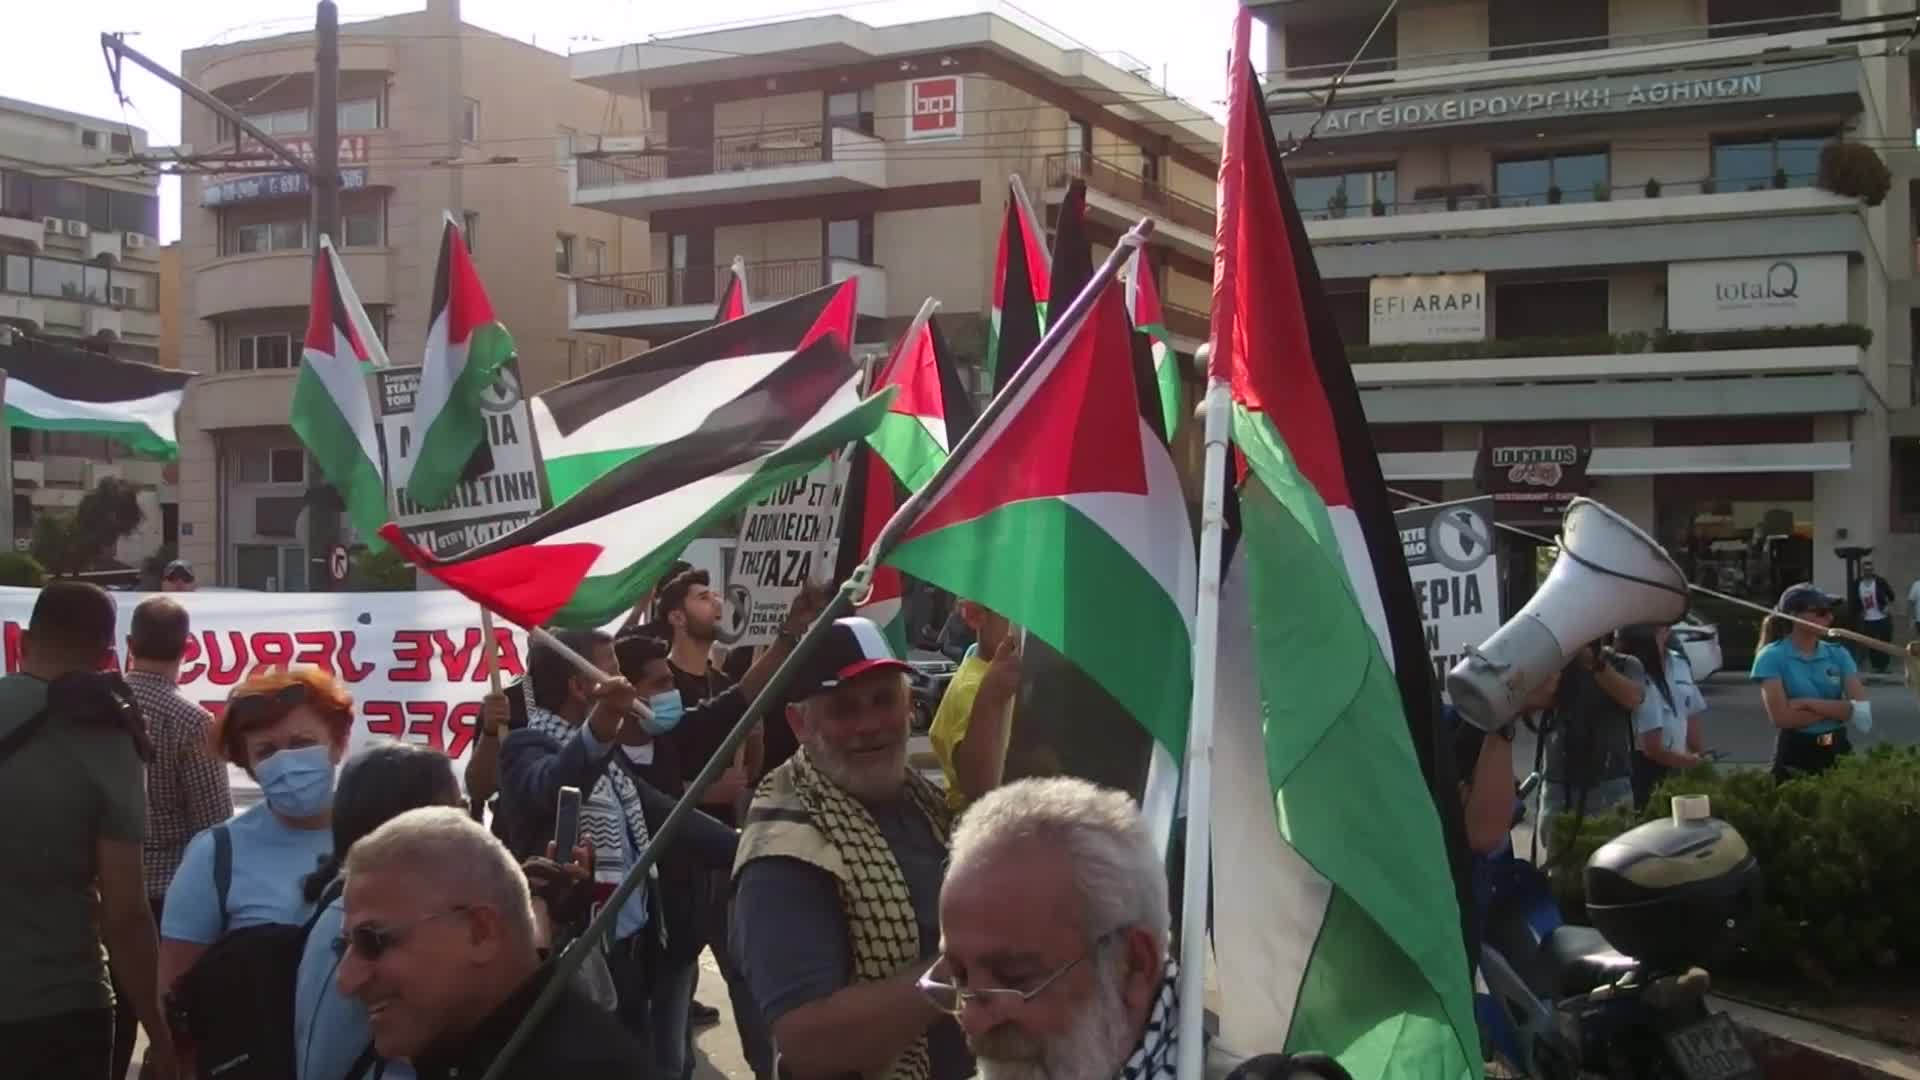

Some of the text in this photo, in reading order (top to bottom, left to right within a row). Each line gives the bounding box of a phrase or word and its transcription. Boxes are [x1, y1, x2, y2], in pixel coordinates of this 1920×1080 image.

[1627, 73, 1762, 105] ΑΘΗΝΩΝ
[1373, 292, 1480, 315] EFI ARAPI
